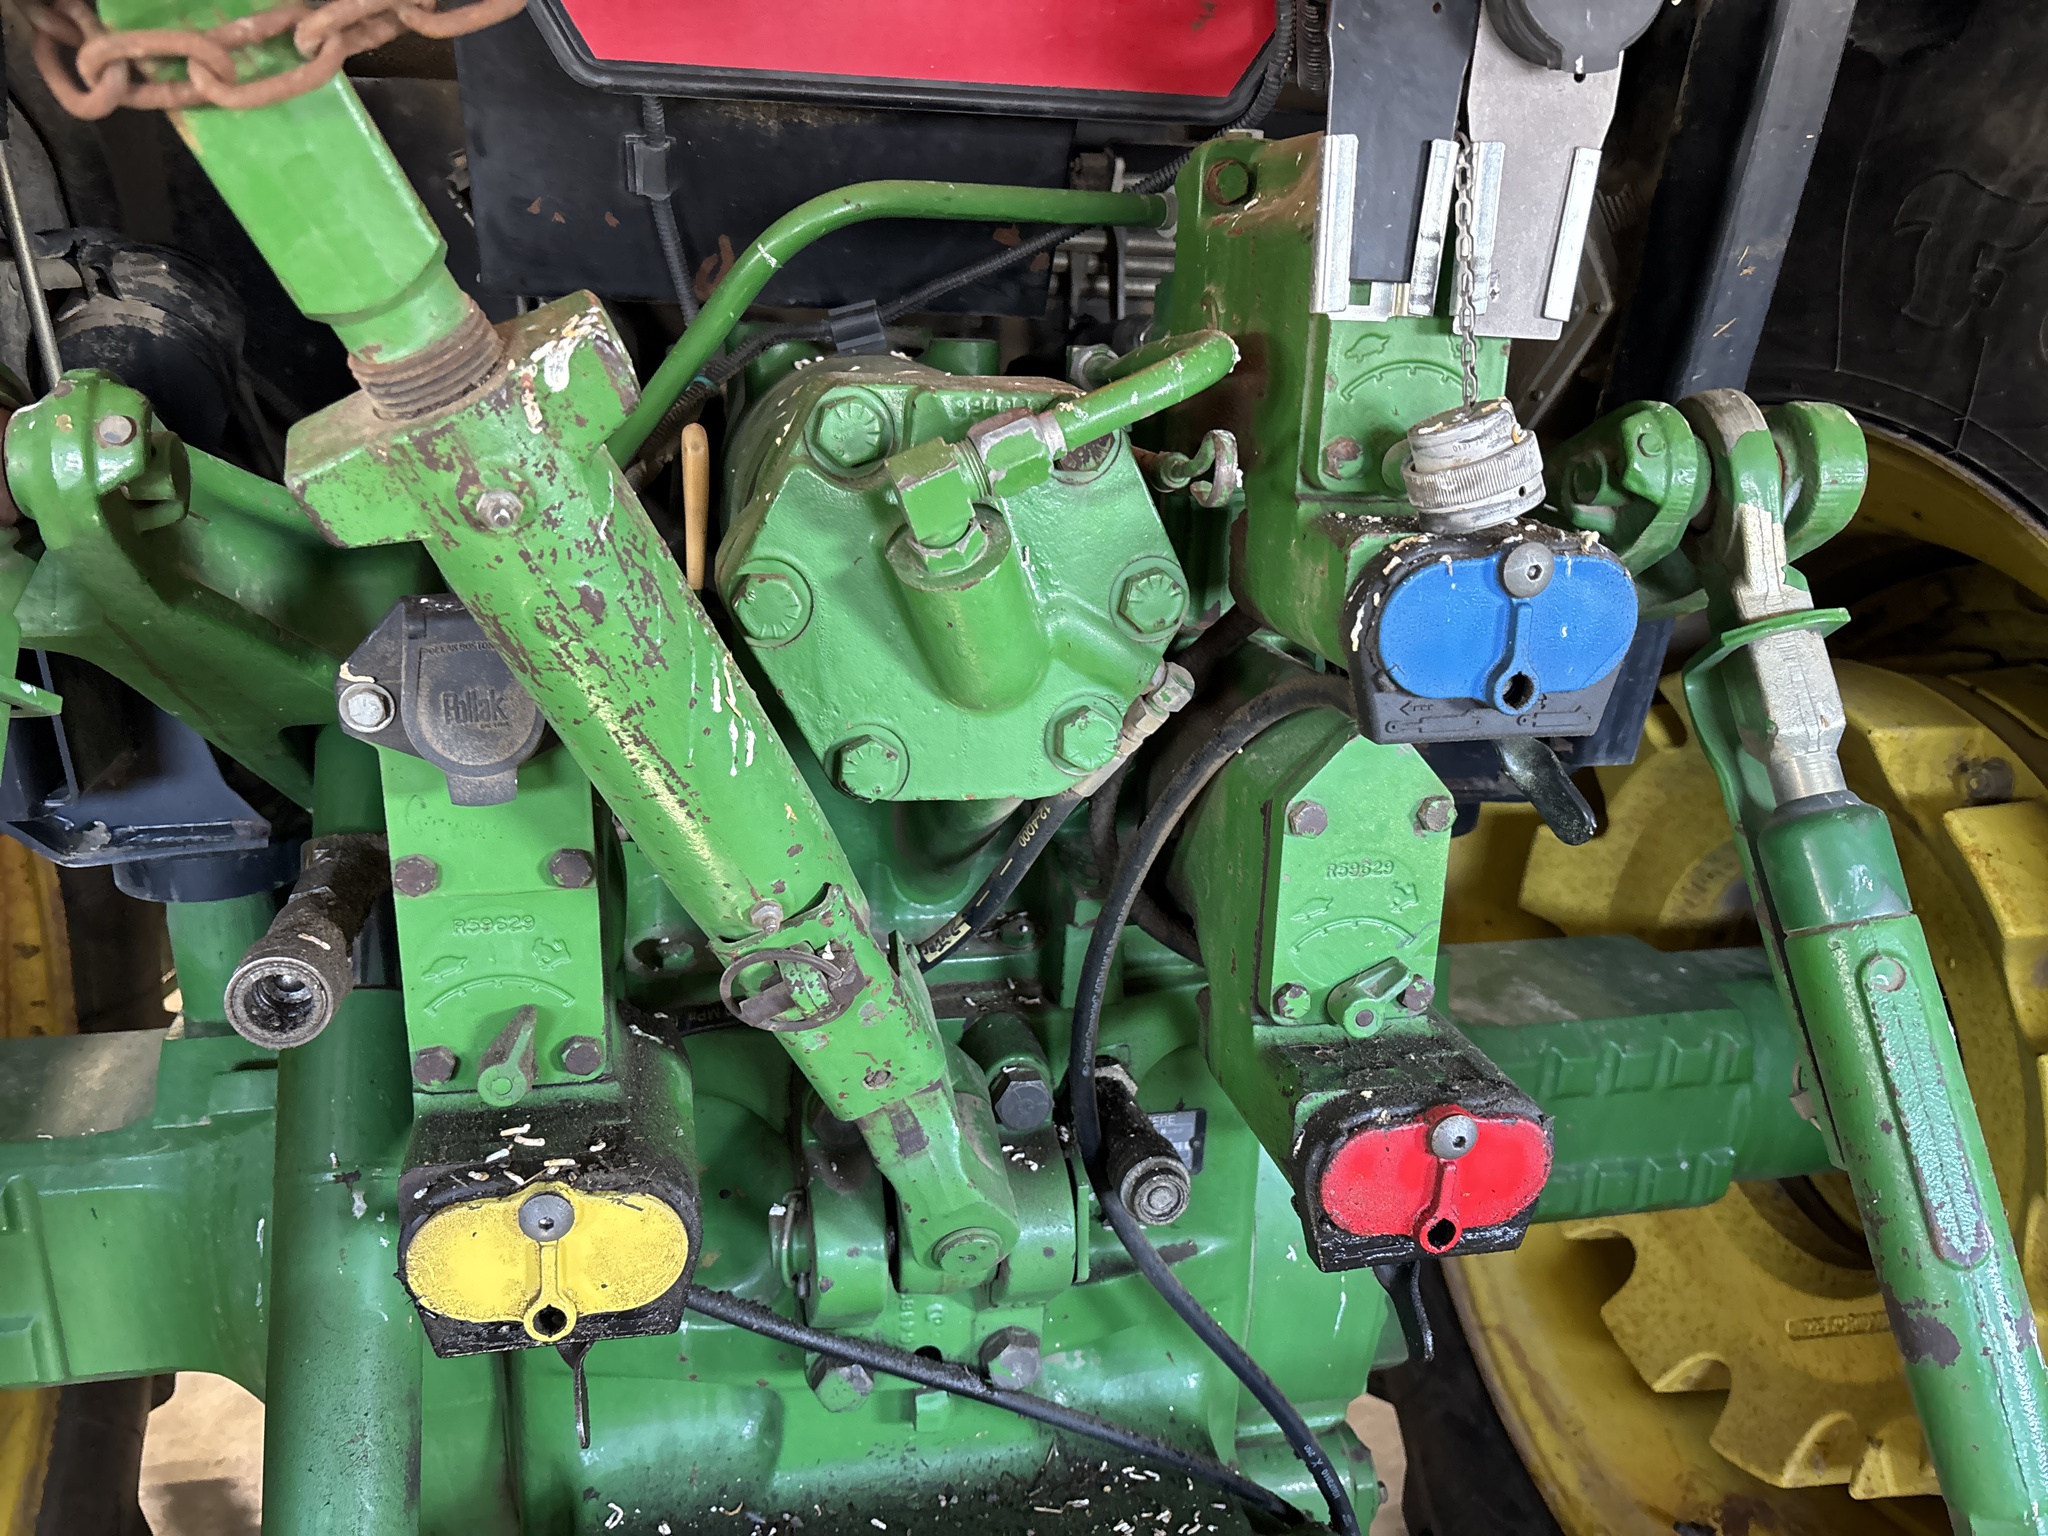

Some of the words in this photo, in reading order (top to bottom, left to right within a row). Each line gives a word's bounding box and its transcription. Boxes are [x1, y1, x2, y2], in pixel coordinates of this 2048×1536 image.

[441, 688, 509, 725] Pollak
[1018, 804, 1051, 848] 12-4000
[1326, 859, 1395, 878] R59629
[452, 915, 535, 935] R59629
